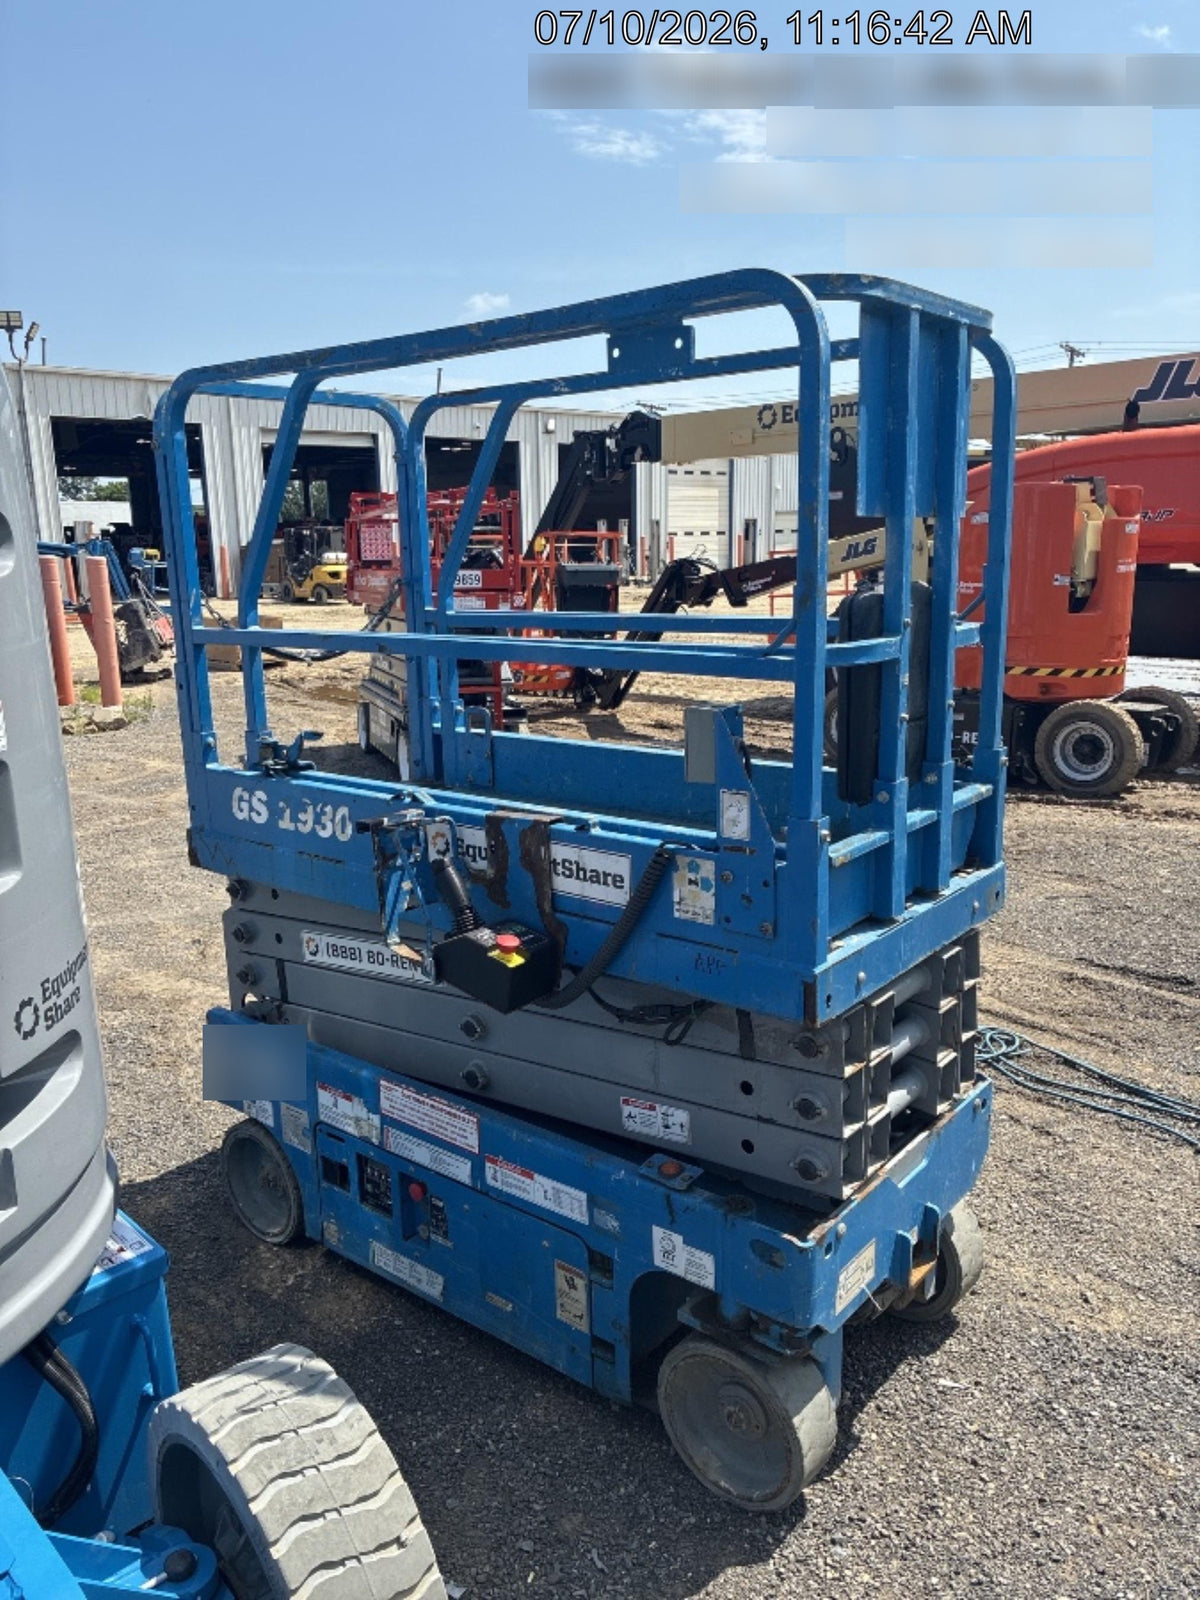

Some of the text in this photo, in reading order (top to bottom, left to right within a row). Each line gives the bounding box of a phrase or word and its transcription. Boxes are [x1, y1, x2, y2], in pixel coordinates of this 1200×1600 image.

[1130, 357, 1200, 403] JL
[841, 537, 877, 562] JLG
[232, 786, 353, 842] GS 1930
[326, 941, 362, 963] (888)
[43, 986, 81, 1032] Share
